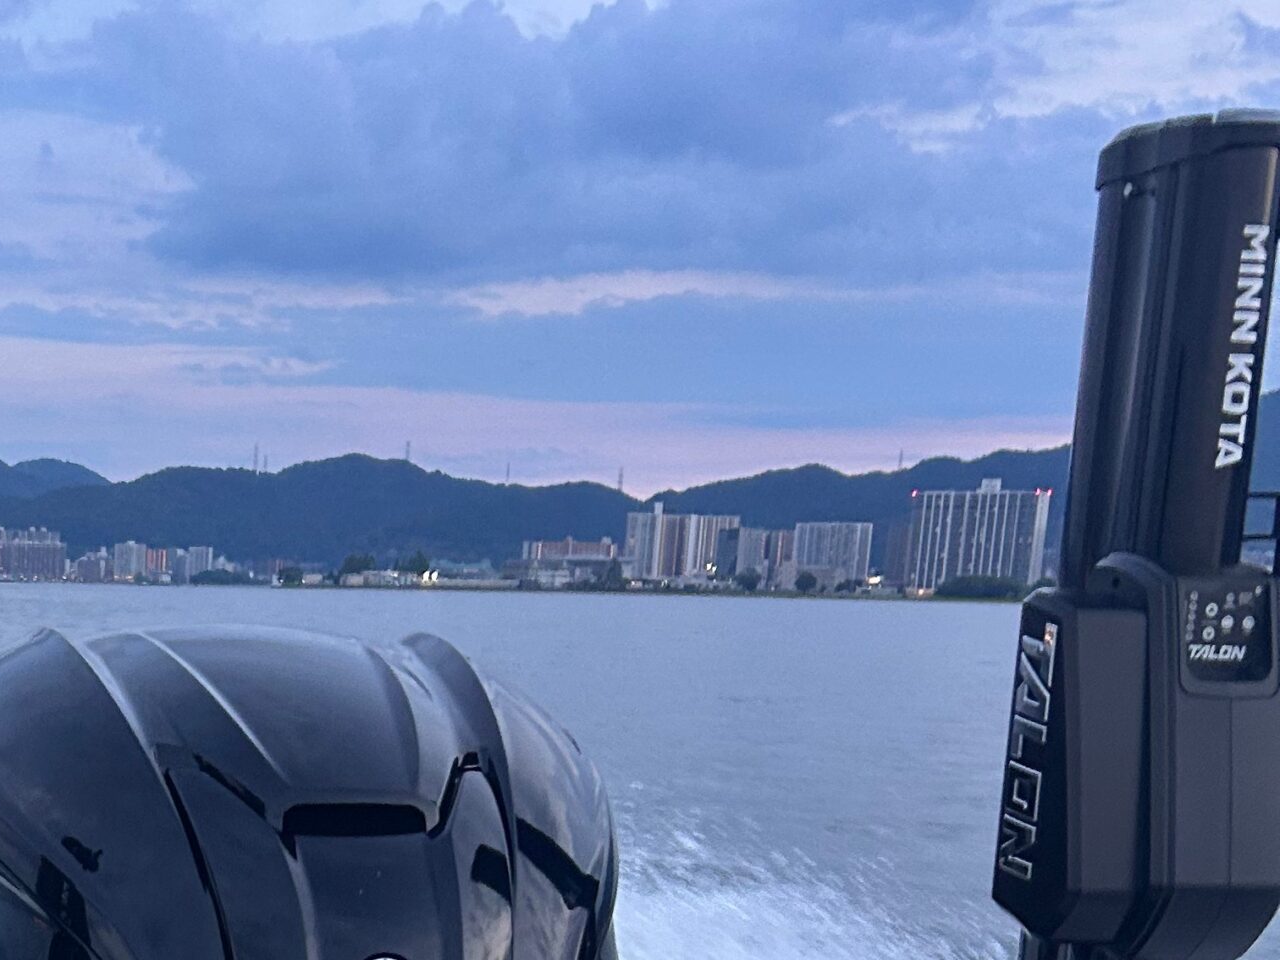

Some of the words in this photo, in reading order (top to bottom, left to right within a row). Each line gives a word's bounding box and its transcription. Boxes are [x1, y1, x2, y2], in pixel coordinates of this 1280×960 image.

[1230, 224, 1270, 344] MINN
[1215, 353, 1255, 469] KOTA
[1188, 644, 1247, 661] TALON
[999, 621, 1058, 881] TALON
